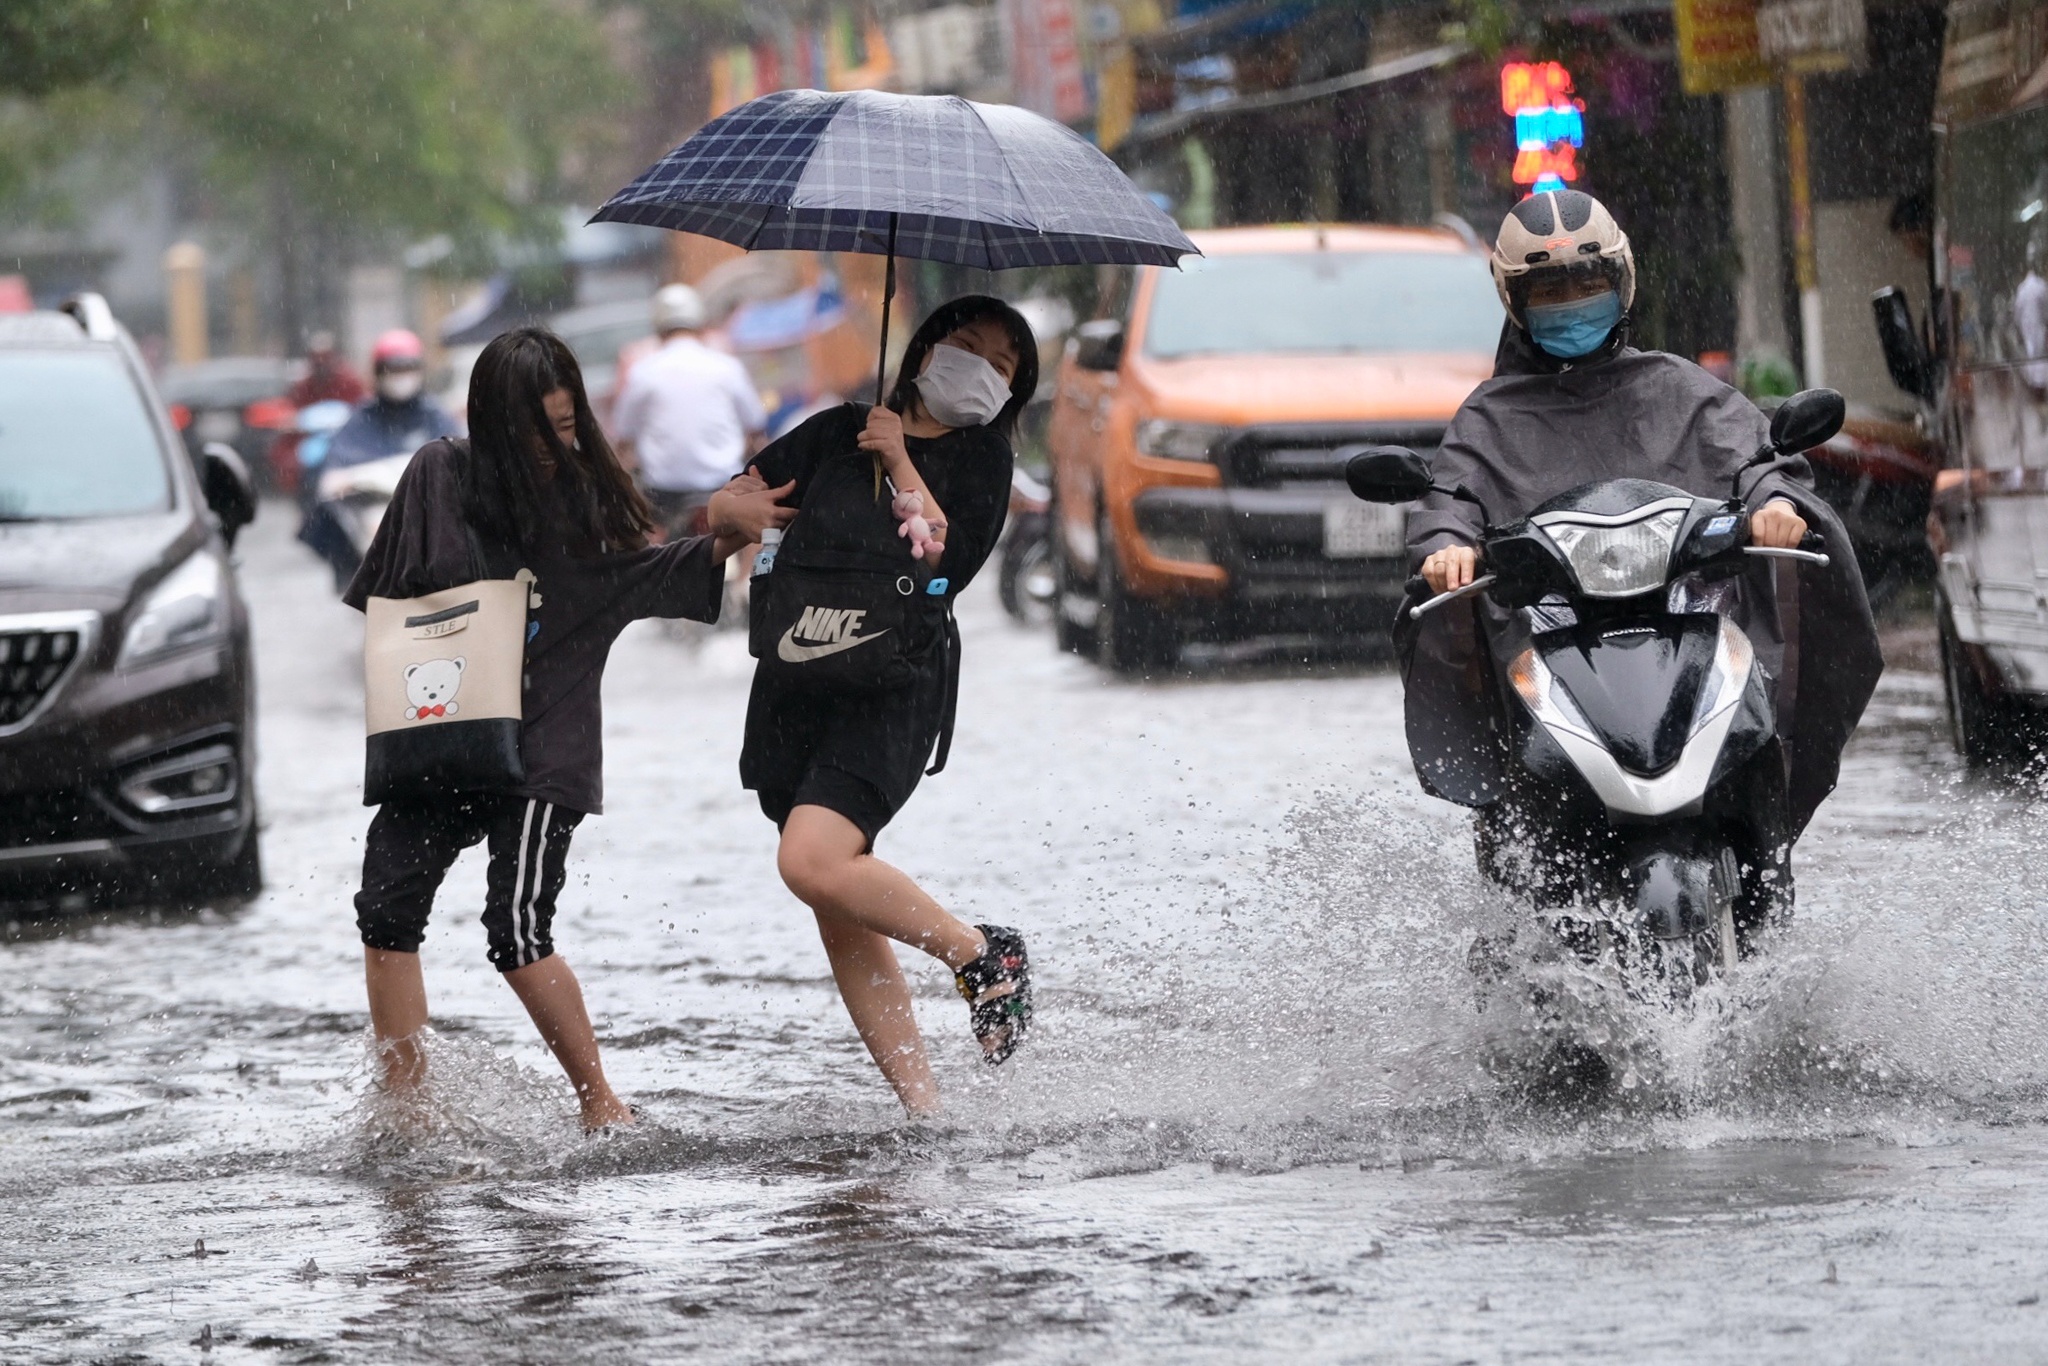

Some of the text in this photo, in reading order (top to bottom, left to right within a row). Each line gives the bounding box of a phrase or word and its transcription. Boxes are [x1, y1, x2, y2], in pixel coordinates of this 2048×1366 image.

[424, 620, 456, 637] STLE
[793, 605, 867, 643] NIKE
[1601, 626, 1657, 638] HONDA
